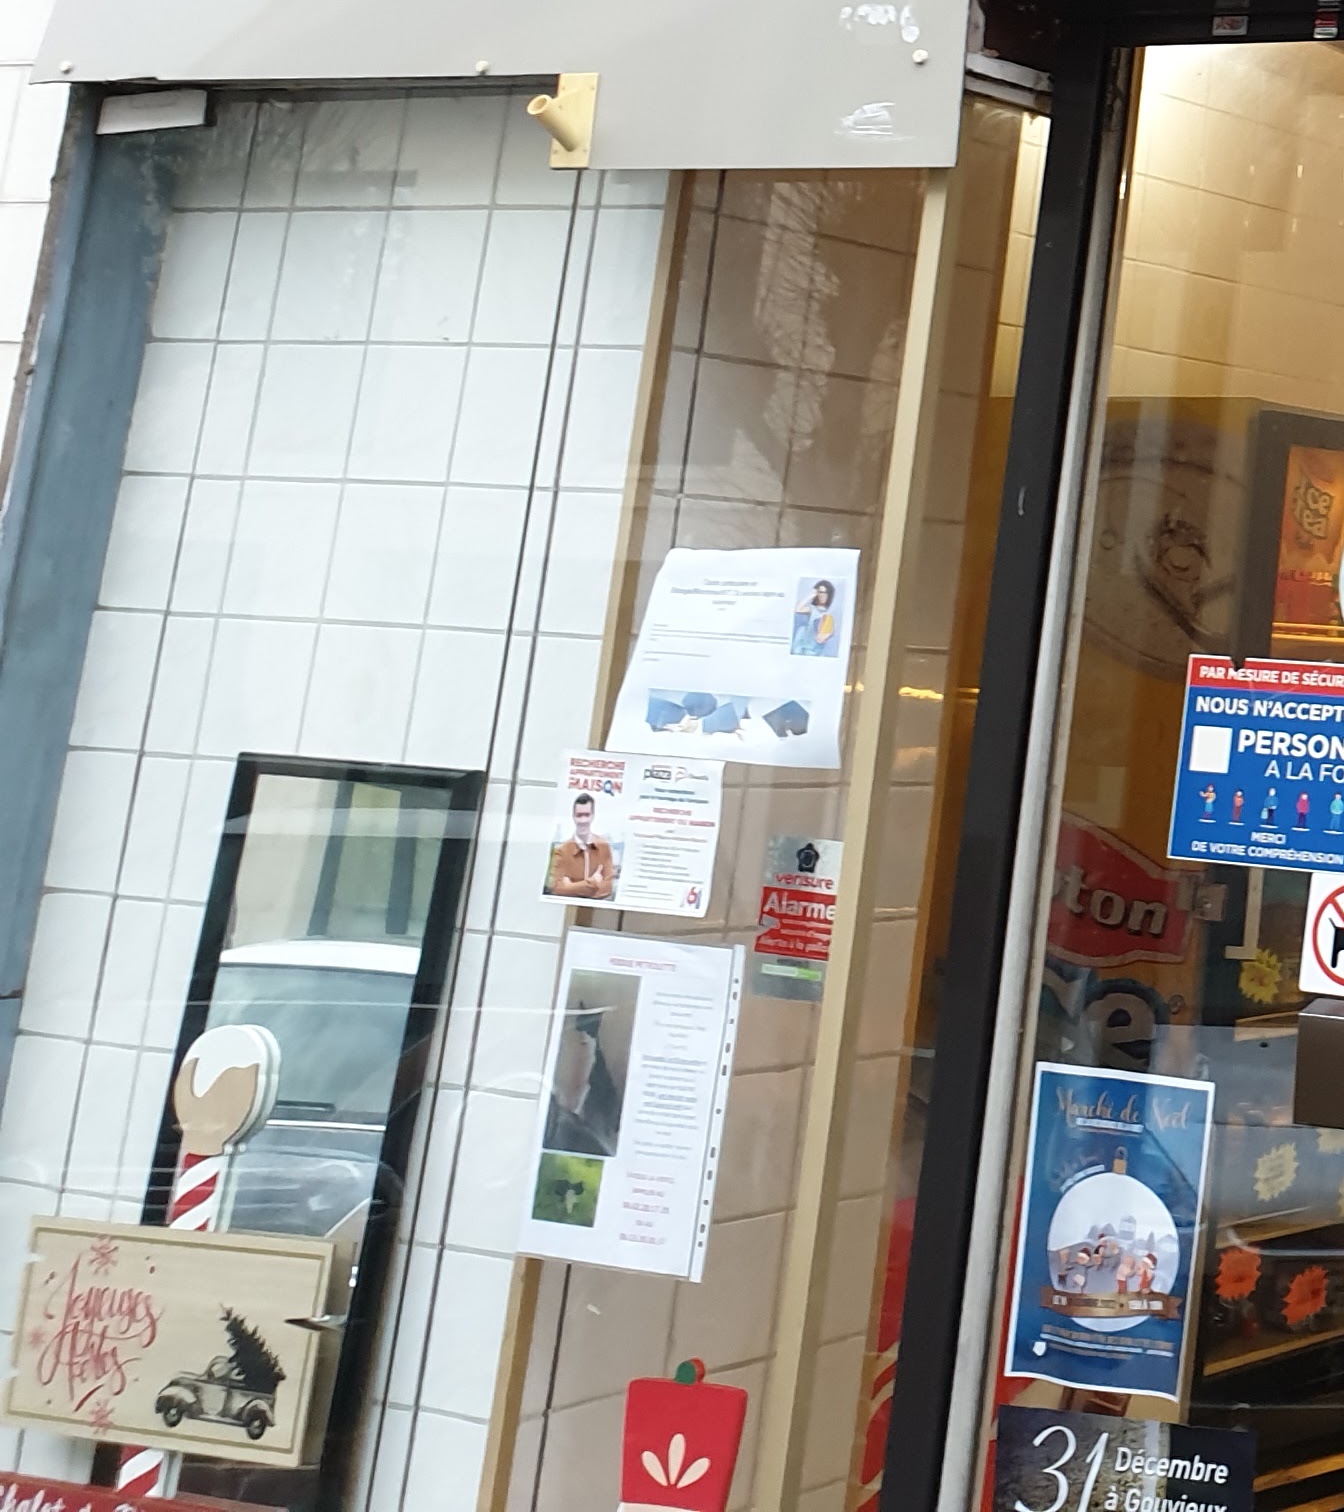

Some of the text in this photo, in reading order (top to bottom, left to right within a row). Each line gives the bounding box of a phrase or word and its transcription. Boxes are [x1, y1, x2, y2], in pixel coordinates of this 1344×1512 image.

[1199, 665, 1227, 679] PAR
[1228, 666, 1278, 684] MESURE
[1281, 671, 1300, 685] DE
[1195, 696, 1248, 715] NOUS
[1264, 759, 1281, 779] A
[1285, 761, 1314, 782] LA
[1250, 831, 1287, 845] MERCI
[1191, 840, 1344, 865] DE VOTRE COMPRÉHENSION
[762, 890, 837, 921] Alarme
[1014, 1425, 1230, 1512] 31 Décembre
[1104, 1484, 1119, 1511] à
